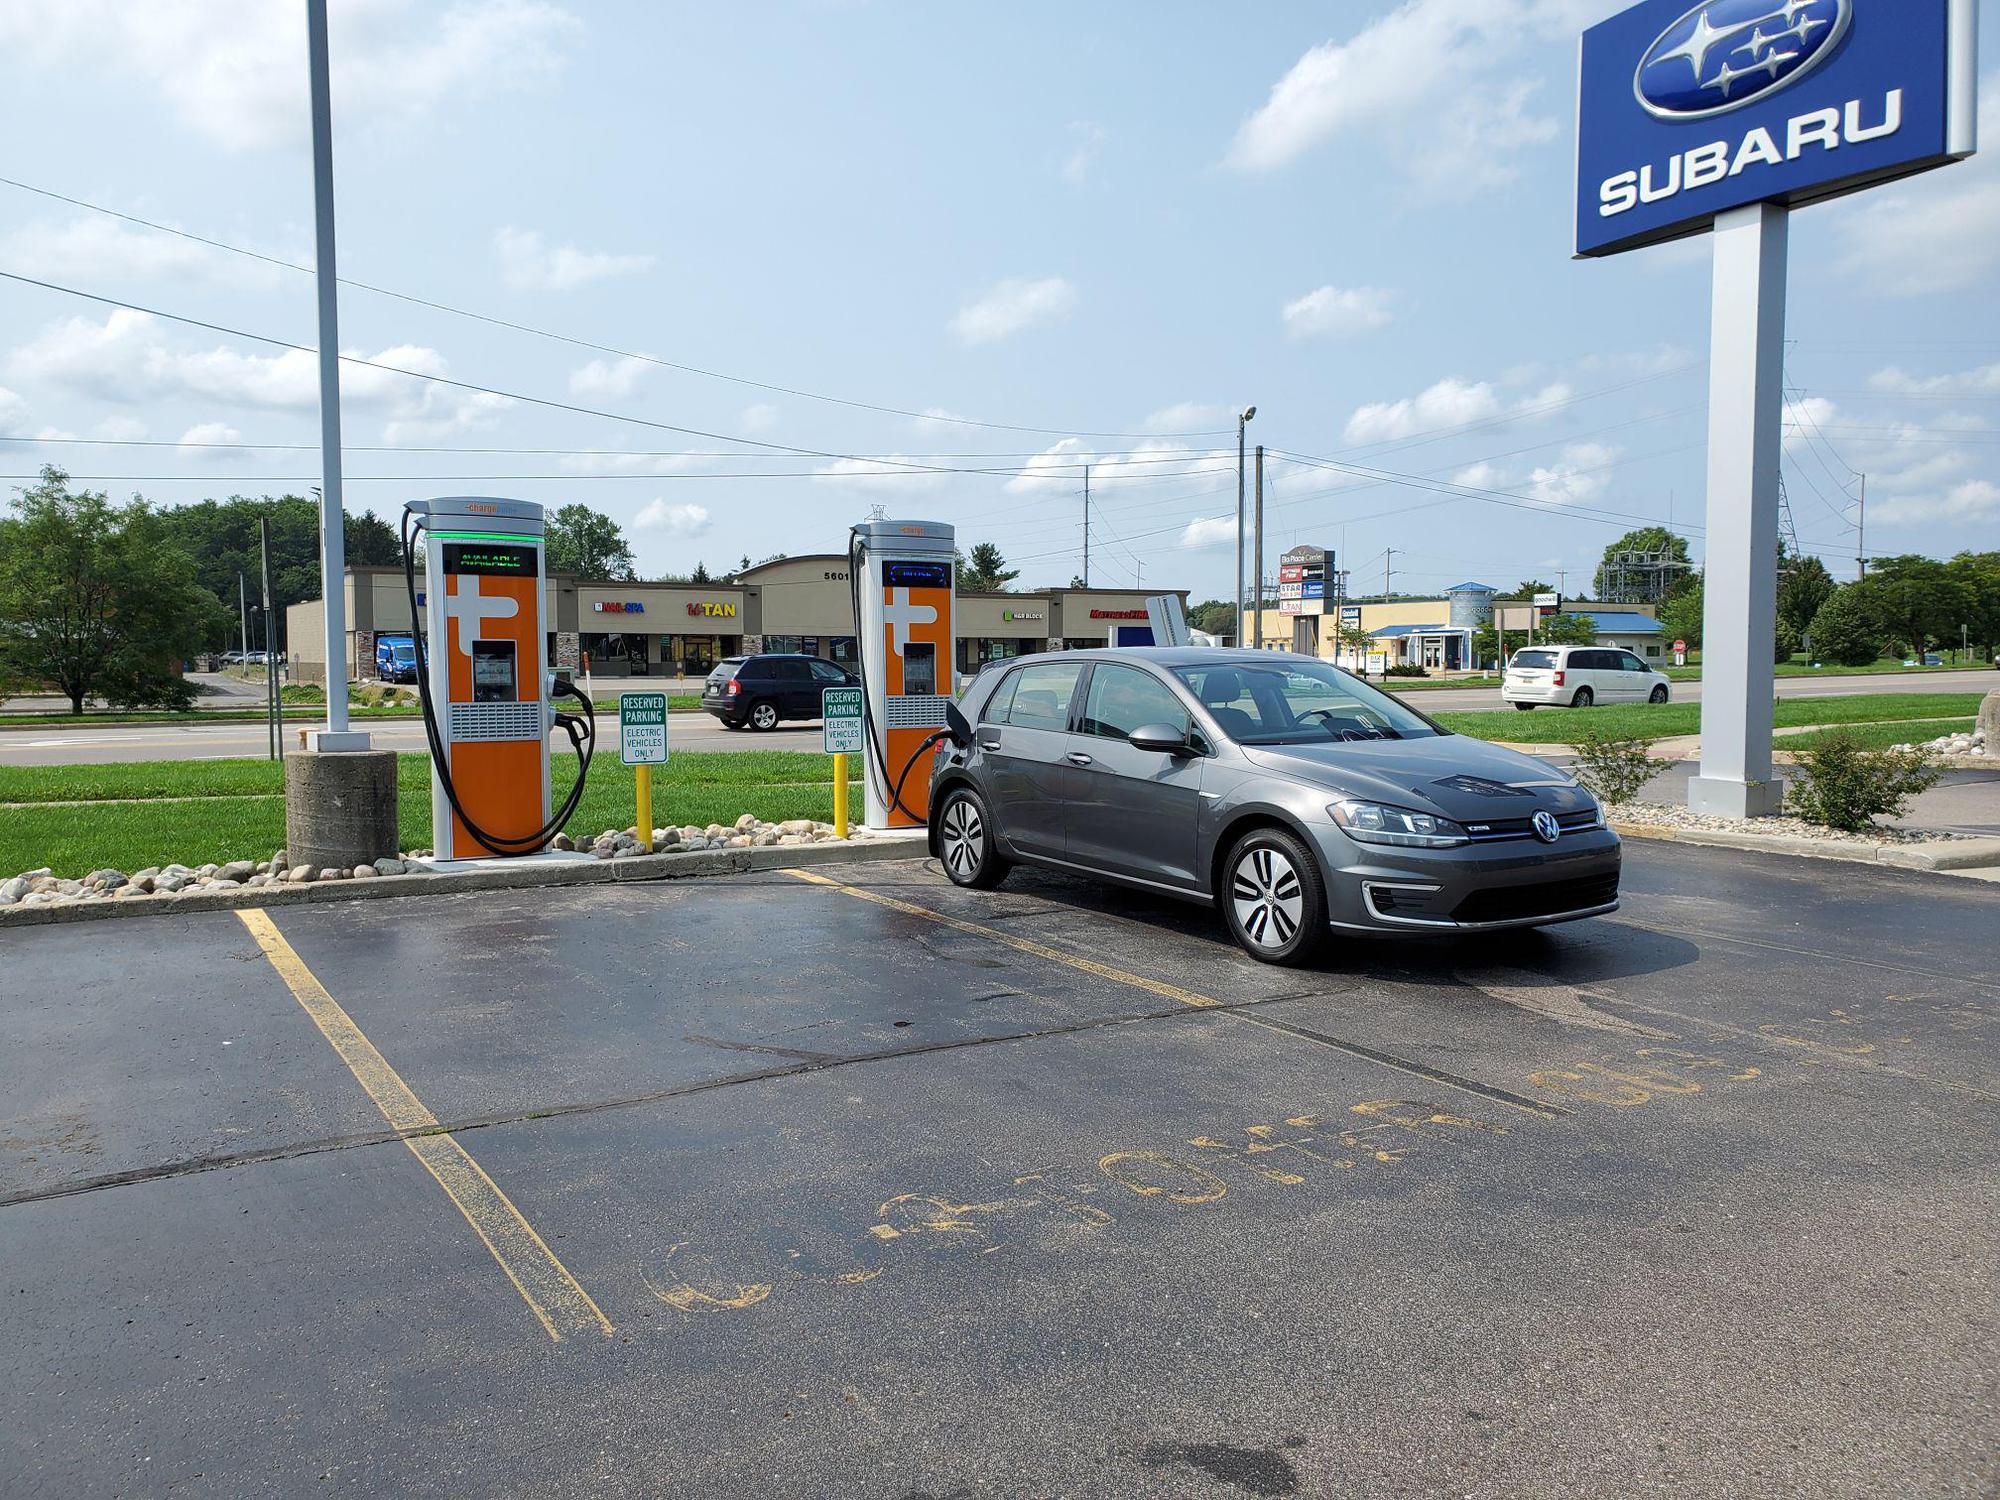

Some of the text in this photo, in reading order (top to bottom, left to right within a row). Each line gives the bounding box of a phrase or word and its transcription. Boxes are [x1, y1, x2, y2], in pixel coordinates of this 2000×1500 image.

[1599, 88, 1903, 217] SUBARU
[824, 572, 849, 580] 5601
[702, 603, 736, 617] TAN
[825, 691, 860, 703] RESERVED
[623, 697, 664, 709] RESERVED
[827, 704, 859, 716] PARKING
[625, 710, 662, 723] PARKING
[828, 720, 858, 729] ELECTRIC
[627, 728, 662, 738] ELECTRIC
[828, 730, 859, 738] VEHICLES
[627, 738, 662, 748] VEHICLES
[835, 740, 852, 748] ONLY
[634, 749, 654, 758] ONLY
[637, 1099, 1508, 1312] CSTOMER
